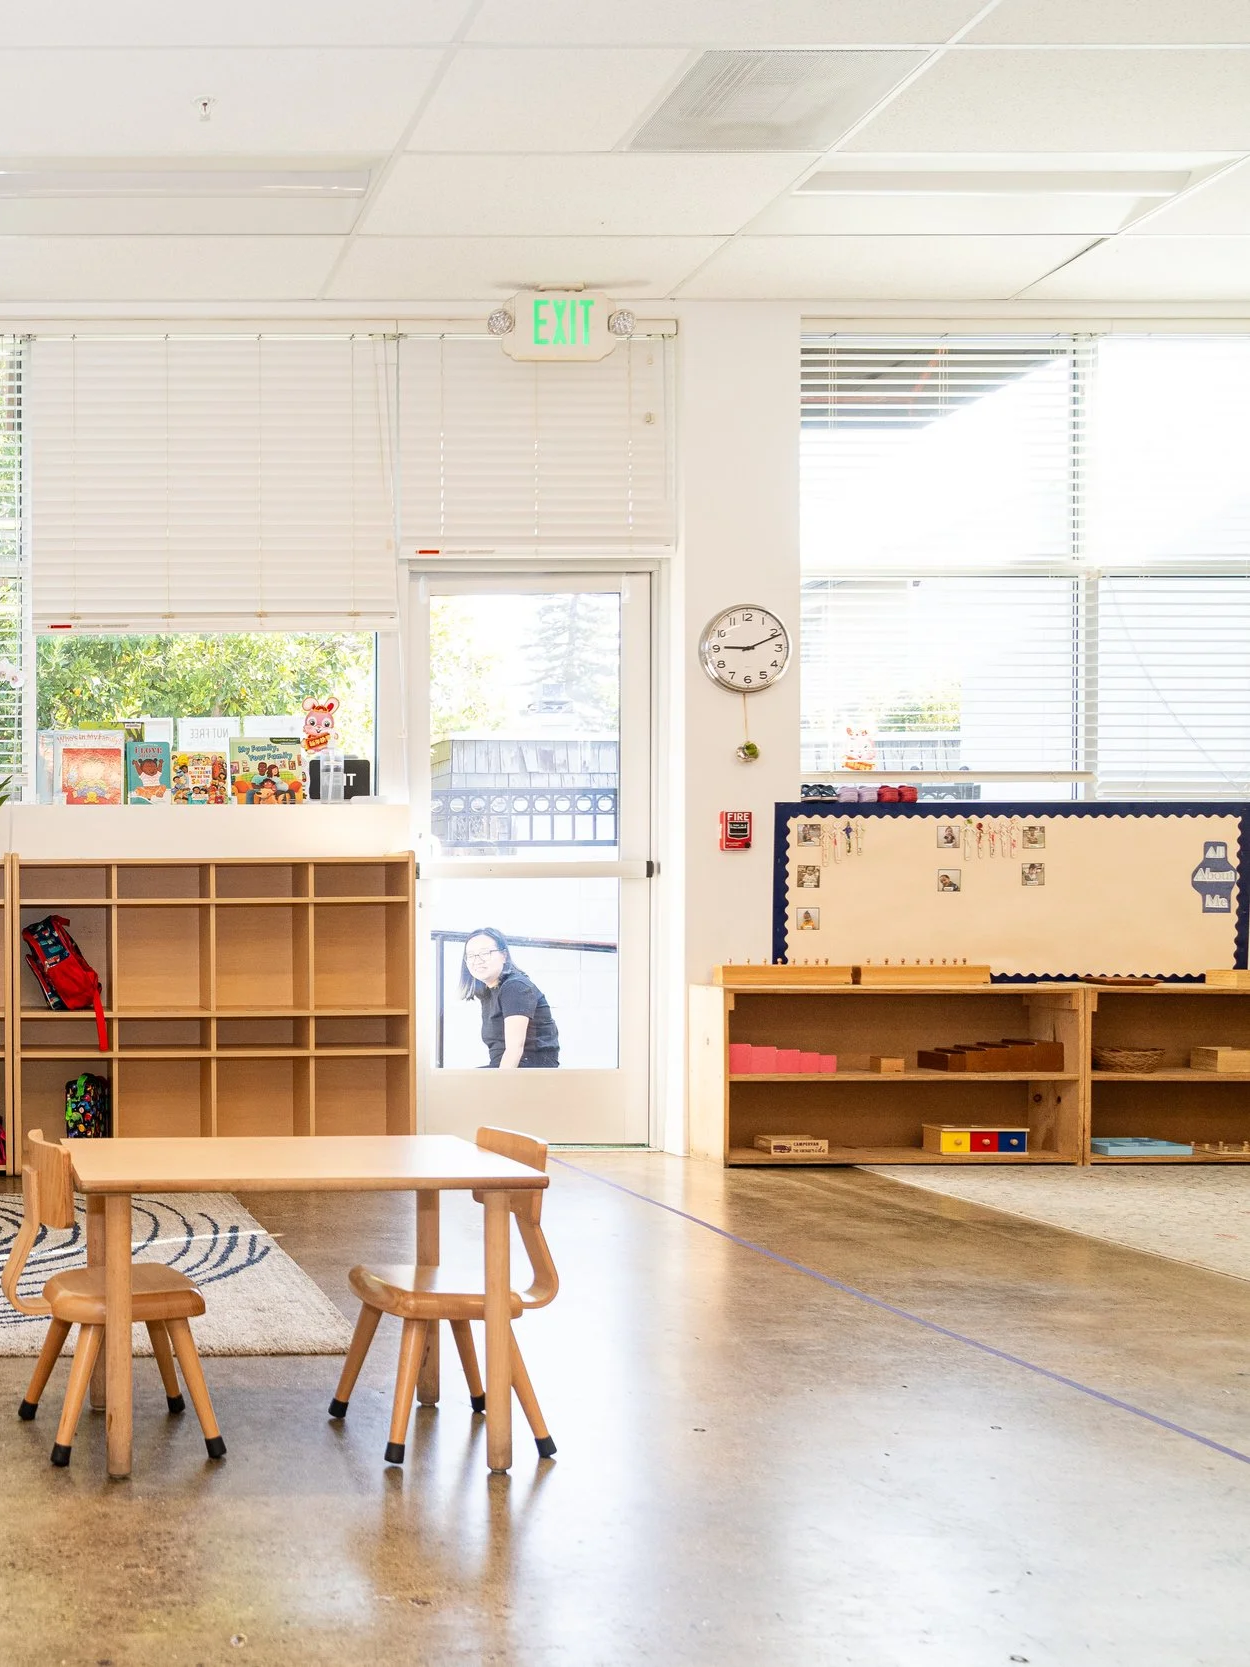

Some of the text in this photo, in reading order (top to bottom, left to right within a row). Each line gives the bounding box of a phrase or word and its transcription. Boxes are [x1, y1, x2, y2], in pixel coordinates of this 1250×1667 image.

[533, 299, 595, 345] EXIT
[730, 617, 736, 626] 11
[742, 613, 753, 622] 12
[717, 630, 726, 638] 10
[770, 628, 778, 637] 2
[712, 645, 721, 653] 9
[774, 644, 783, 652] 3
[717, 660, 726, 668] 8
[729, 671, 736, 680] 7
[743, 675, 752, 684] 6
[759, 671, 768, 679] 5
[727, 812, 750, 821] FIRE
[1206, 846, 1226, 859] All
[1193, 867, 1236, 882] About
[1205, 894, 1228, 908] Me
